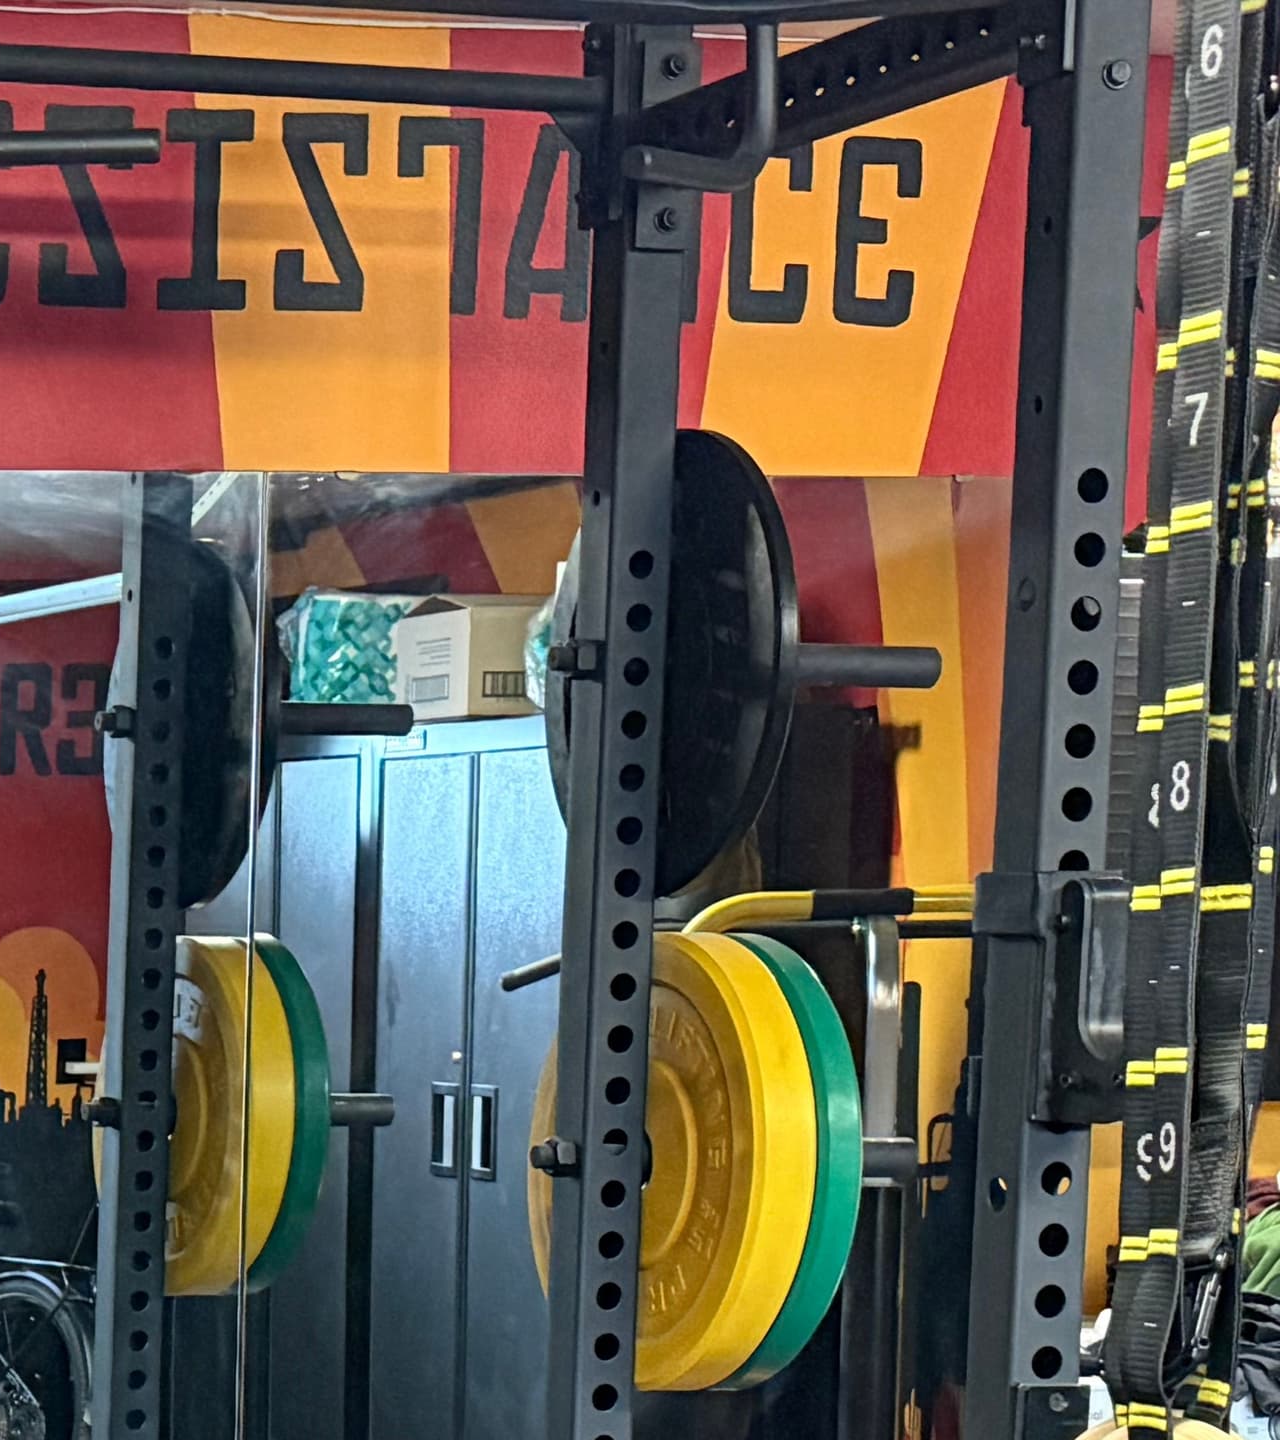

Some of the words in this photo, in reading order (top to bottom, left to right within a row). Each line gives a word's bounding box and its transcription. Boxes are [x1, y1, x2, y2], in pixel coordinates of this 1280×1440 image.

[1200, 24, 1224, 77] 6
[1185, 392, 1208, 446] 7
[1169, 760, 1190, 811] 8
